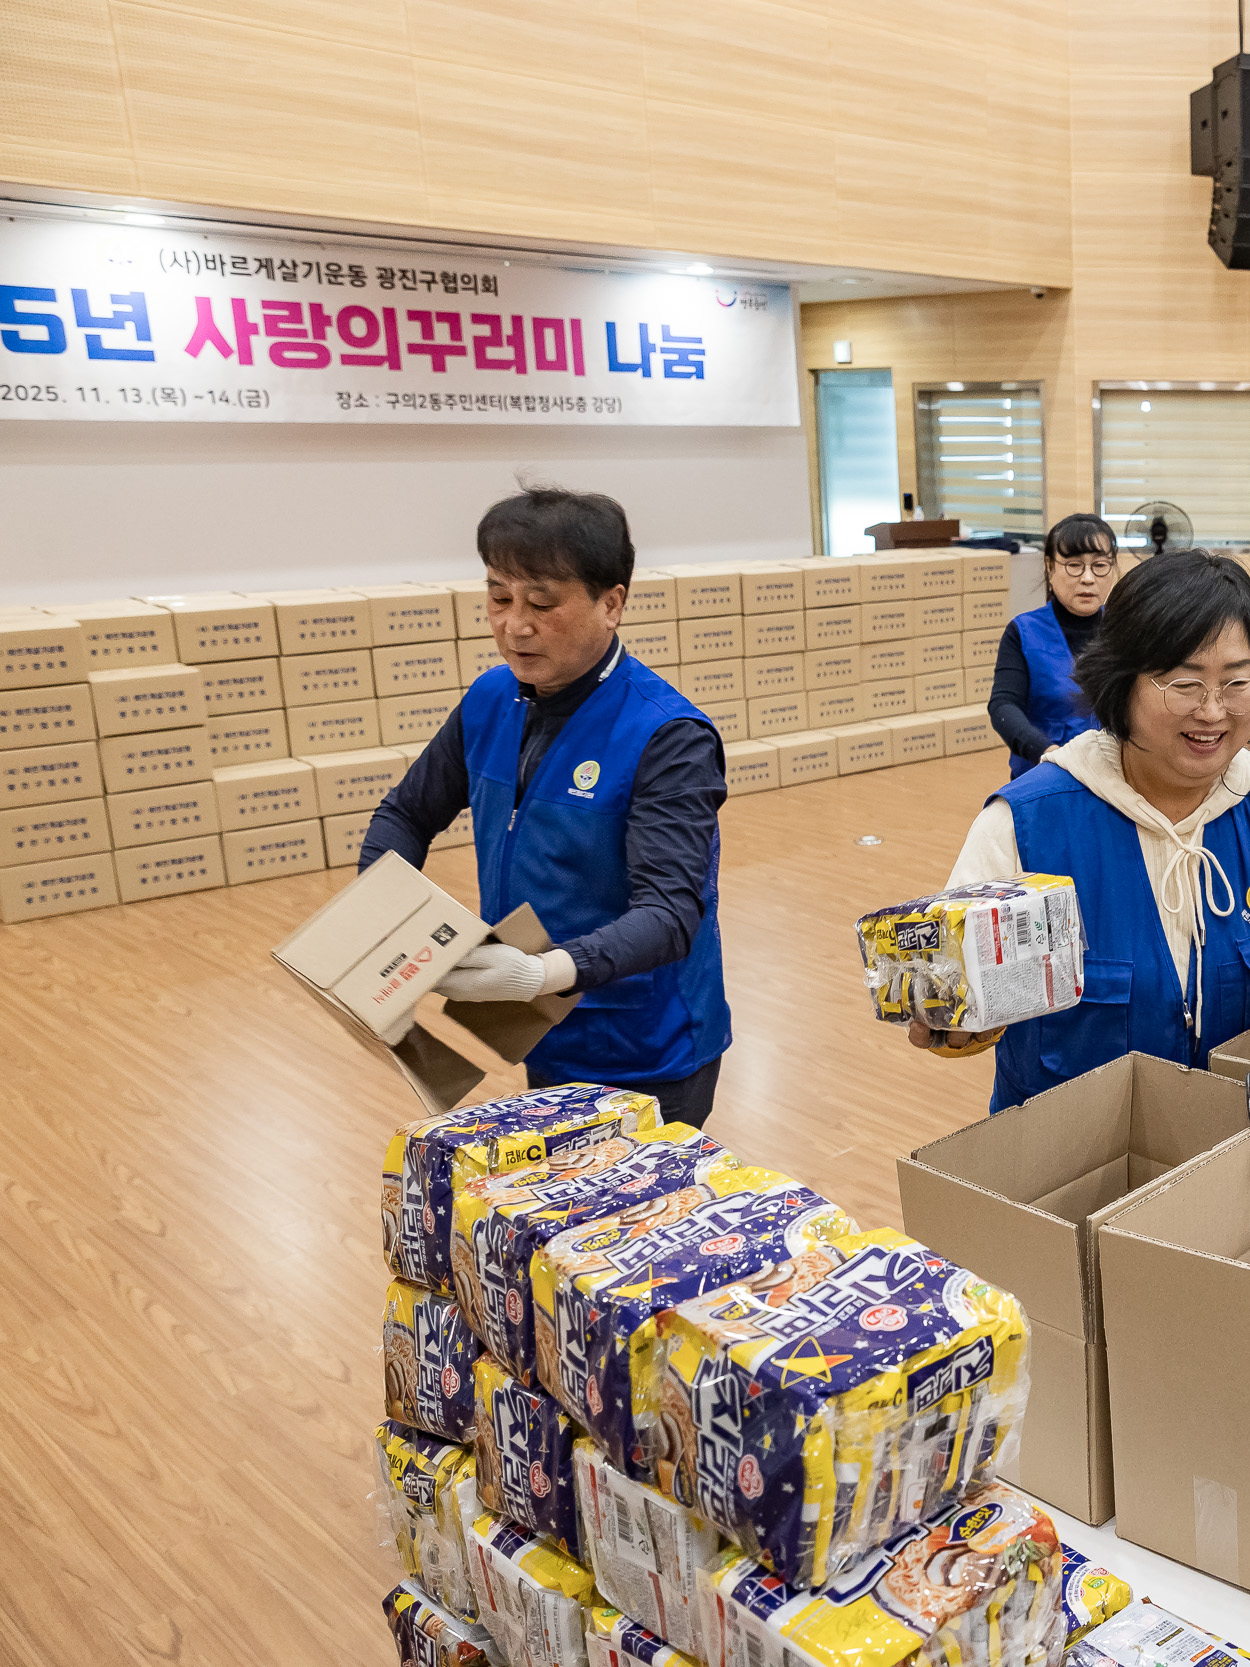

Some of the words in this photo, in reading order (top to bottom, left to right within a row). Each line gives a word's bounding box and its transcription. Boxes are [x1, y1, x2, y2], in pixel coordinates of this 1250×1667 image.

[159, 248, 367, 288] (사)바르게살기운동
[375, 266, 499, 297] 광진구협의회
[0, 284, 156, 362] 5년
[184, 296, 587, 378] 사랑의꾸러미
[605, 321, 706, 380] 나눔
[0, 384, 67, 403] 2025.
[505, 1144, 542, 1166] 5개입
[752, 1243, 925, 1343] 진라면
[959, 1504, 993, 1539] 순한맛
